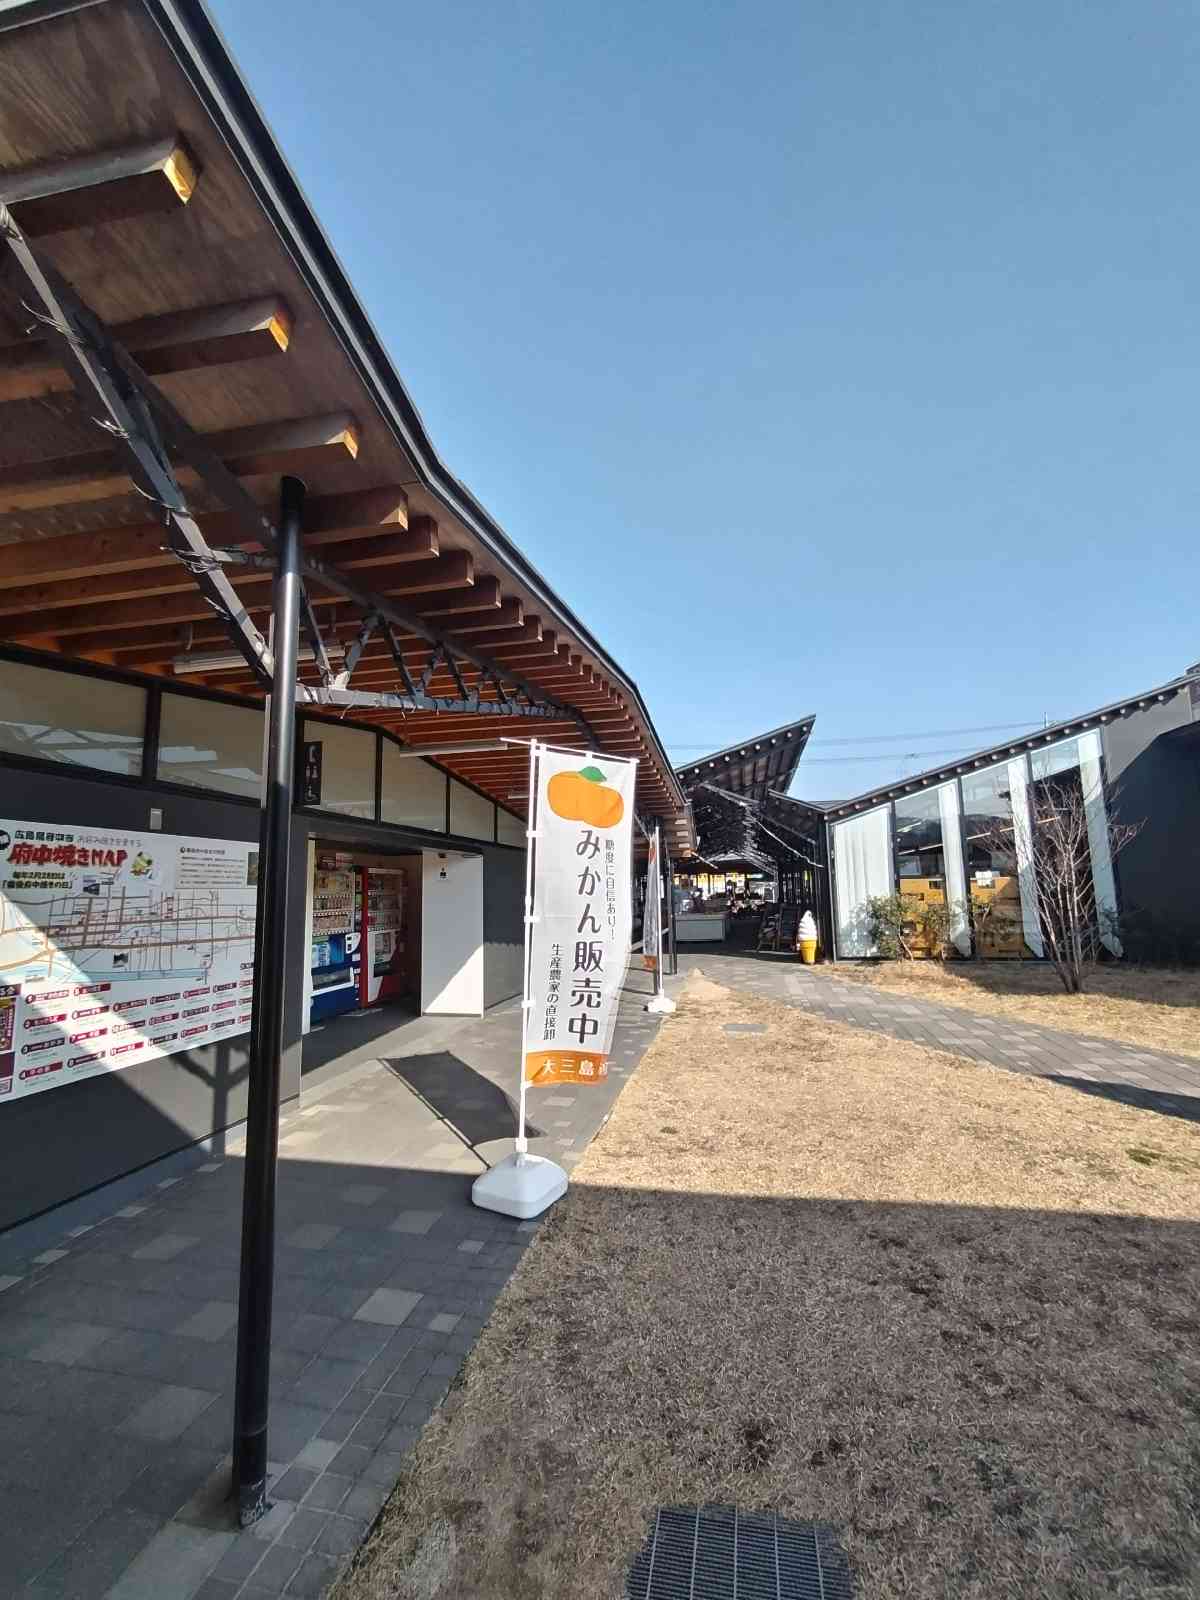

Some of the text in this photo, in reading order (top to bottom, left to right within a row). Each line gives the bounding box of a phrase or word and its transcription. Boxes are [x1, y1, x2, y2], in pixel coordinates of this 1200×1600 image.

[568, 830, 604, 1044] みかん販売中
